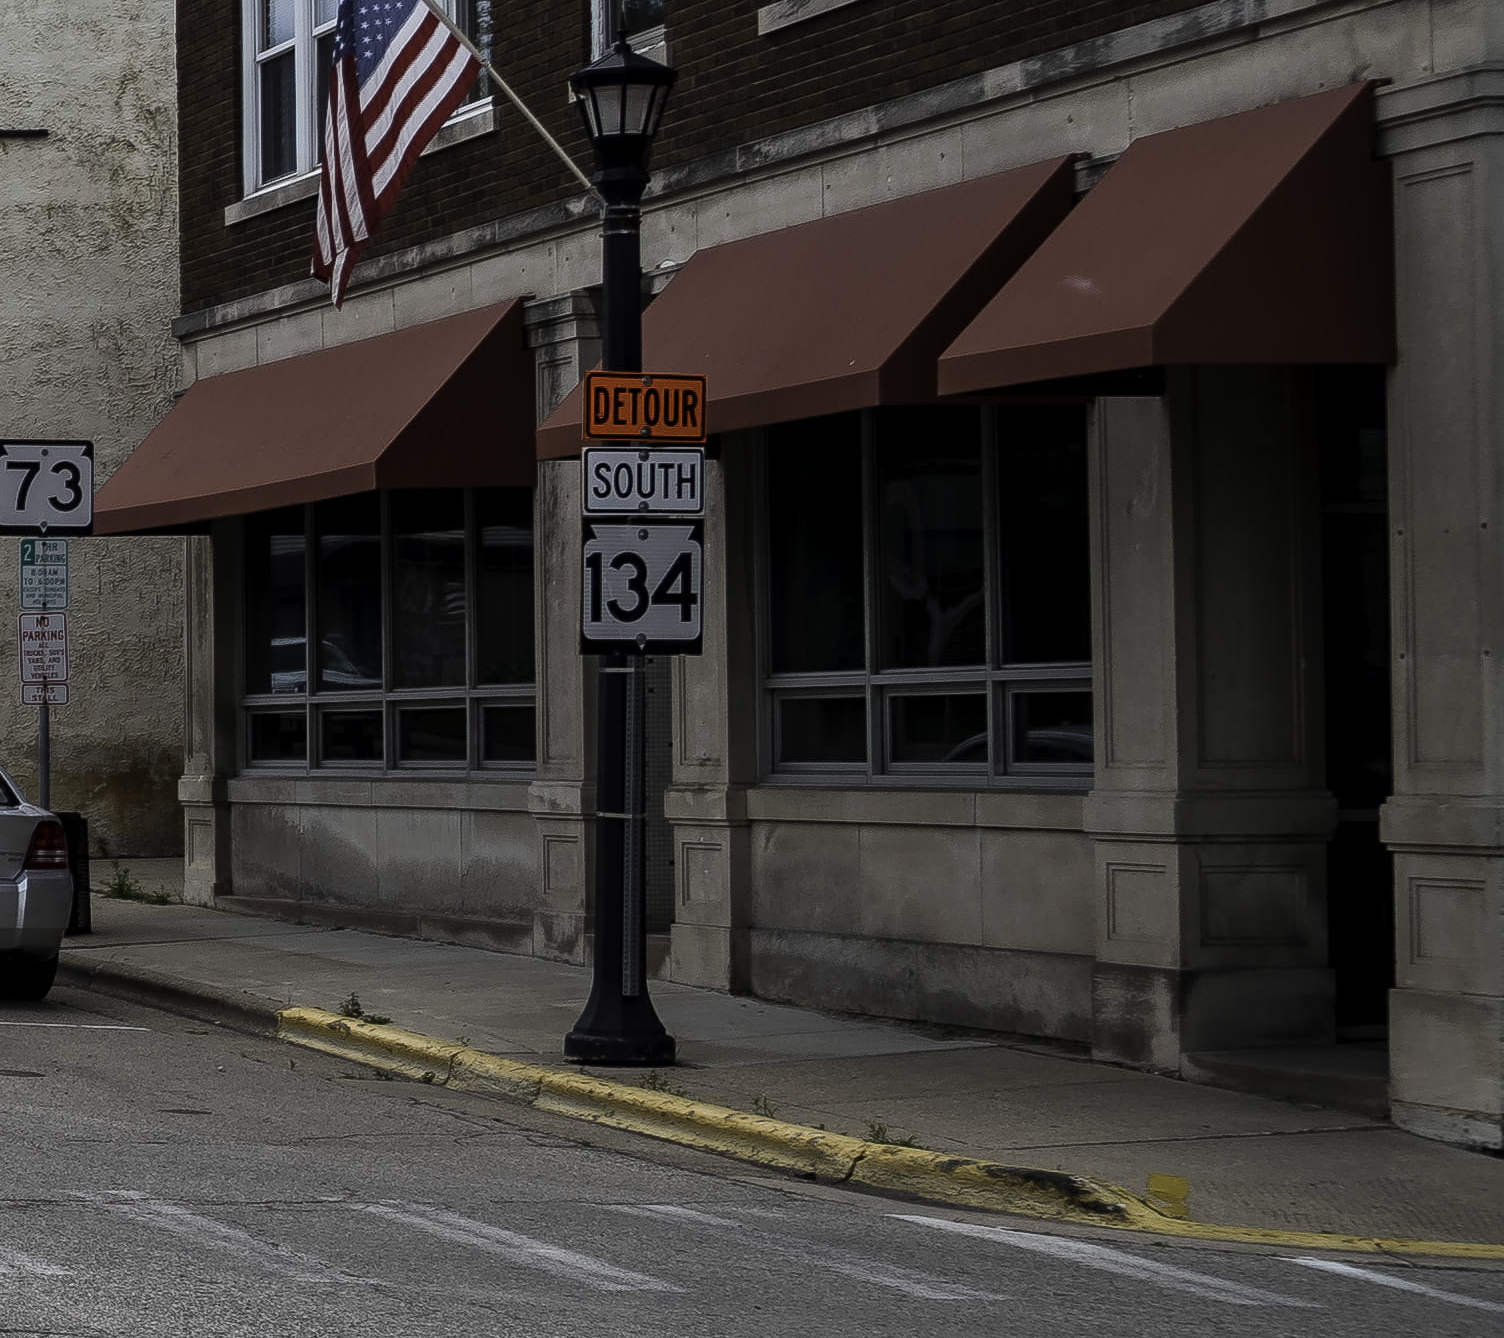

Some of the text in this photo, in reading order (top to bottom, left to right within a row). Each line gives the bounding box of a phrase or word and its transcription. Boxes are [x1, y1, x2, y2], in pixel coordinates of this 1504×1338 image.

[593, 386, 698, 428] DETOUR
[5, 460, 83, 513] 73
[592, 462, 696, 500] SOUTH
[23, 544, 32, 561] 2
[35, 553, 66, 564] PARKING
[23, 577, 34, 586] TO
[585, 551, 699, 623] 134
[35, 616, 50, 628] NO
[22, 629, 65, 642] PARKING
[31, 694, 59, 702] STALL
